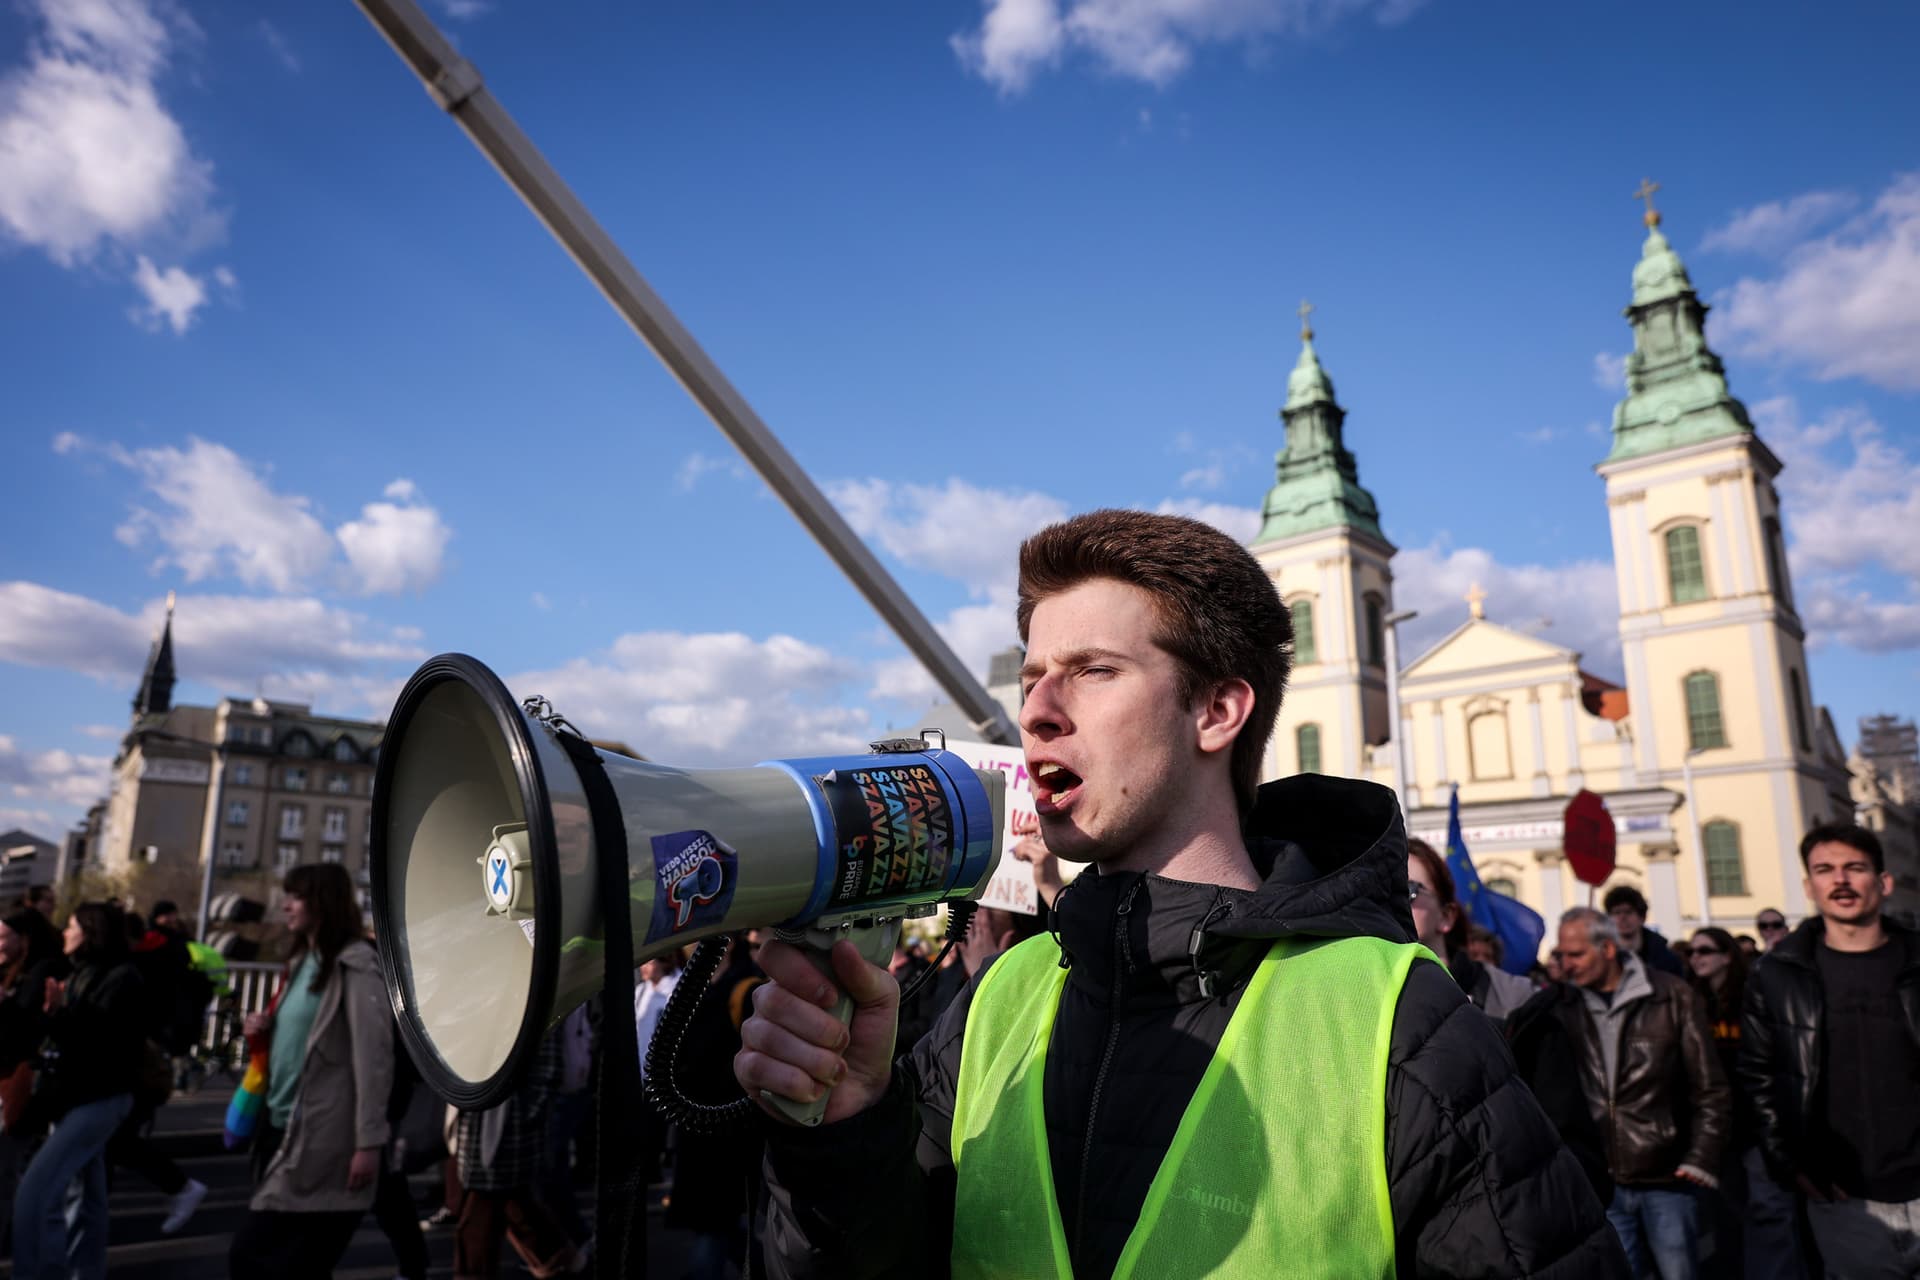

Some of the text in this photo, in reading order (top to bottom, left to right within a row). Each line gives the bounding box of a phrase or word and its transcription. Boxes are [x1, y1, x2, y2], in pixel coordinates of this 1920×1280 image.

[659, 856, 681, 876] VEDD
[852, 772, 890, 895] SZAVAZZ!
[890, 769, 929, 888] SZAVAZZ!
[840, 861, 857, 899] PRIDE
